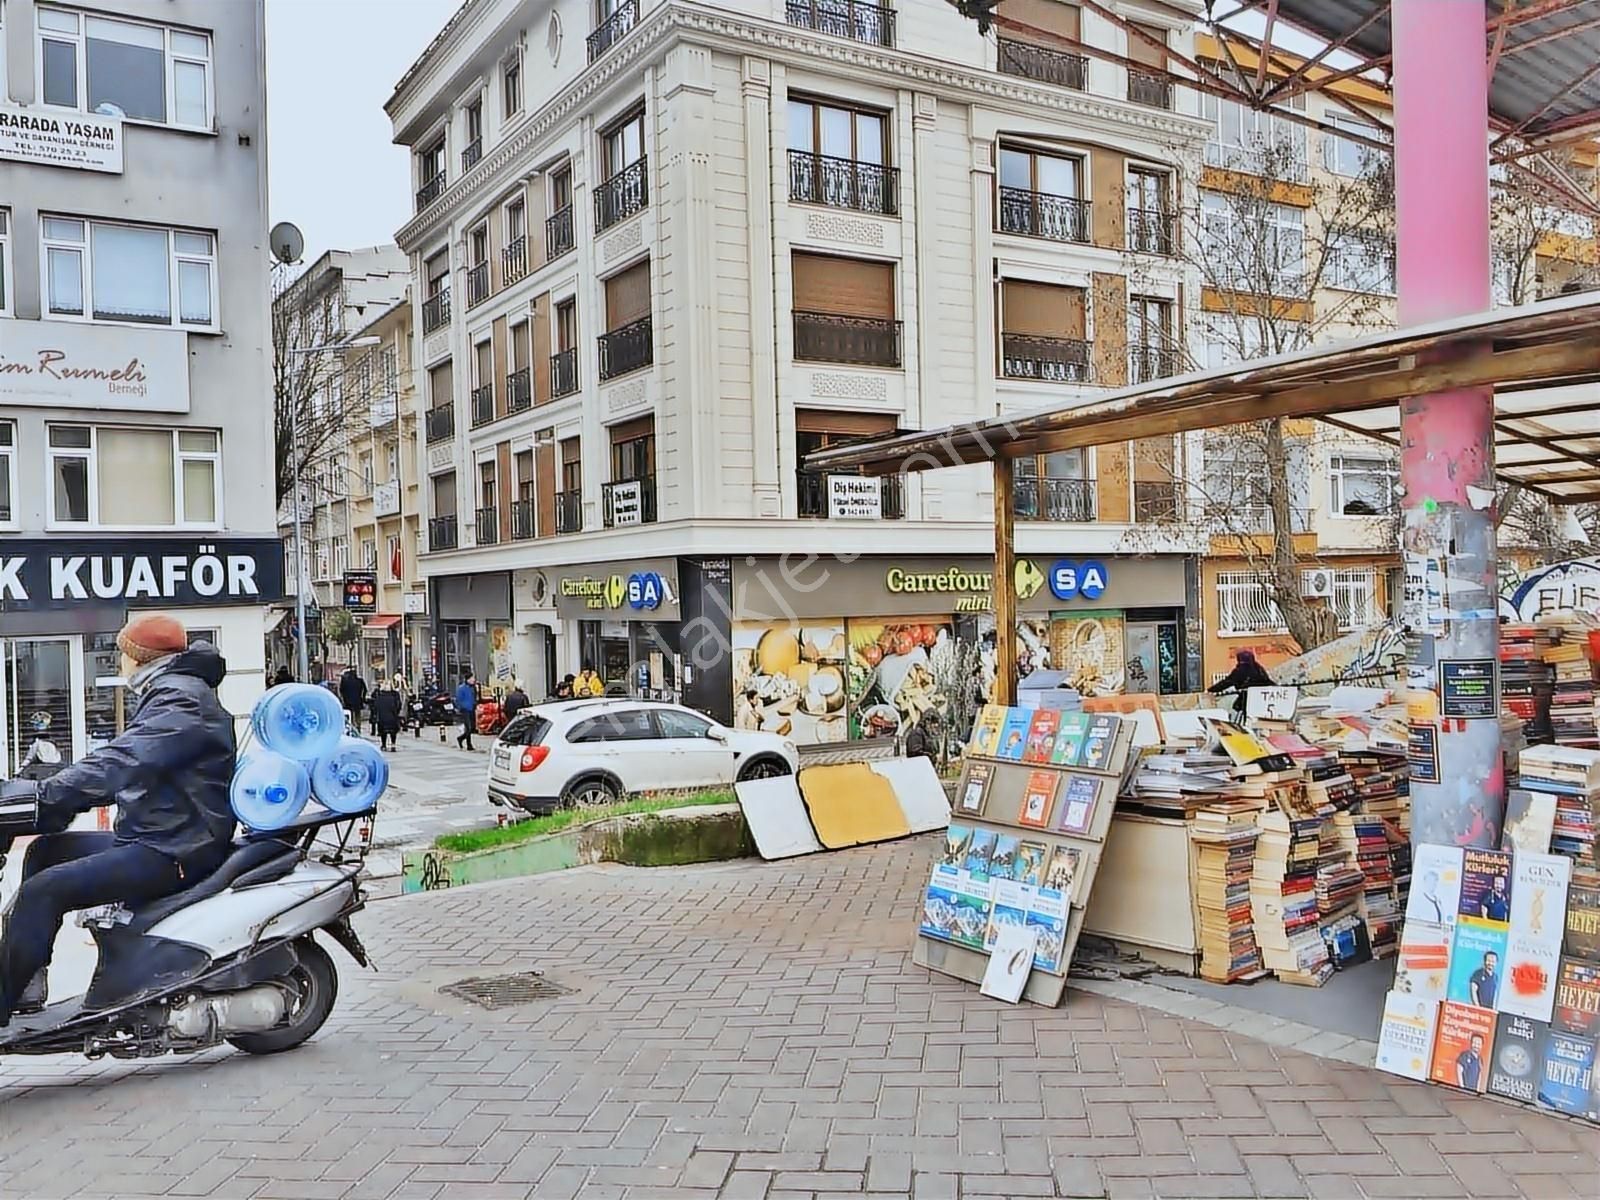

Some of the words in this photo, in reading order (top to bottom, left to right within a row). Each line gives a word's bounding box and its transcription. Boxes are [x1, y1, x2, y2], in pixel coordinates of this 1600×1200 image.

[65, 122, 114, 141] YAŞAM
[38, 350, 146, 382] Rumeli
[834, 481, 846, 495] Diş
[50, 545, 259, 600] KUAFÖR
[886, 567, 992, 593] Carrefour
[1055, 568, 1105, 591] SA
[560, 576, 603, 597] Carrefour
[955, 594, 992, 611] mini
[1260, 690, 1289, 701] TANE
[1465, 851, 1510, 867] Mutluluk
[1465, 862, 1499, 875] Kürleri
[1502, 866, 1509, 877] 2
[1528, 865, 1555, 879] GEN
